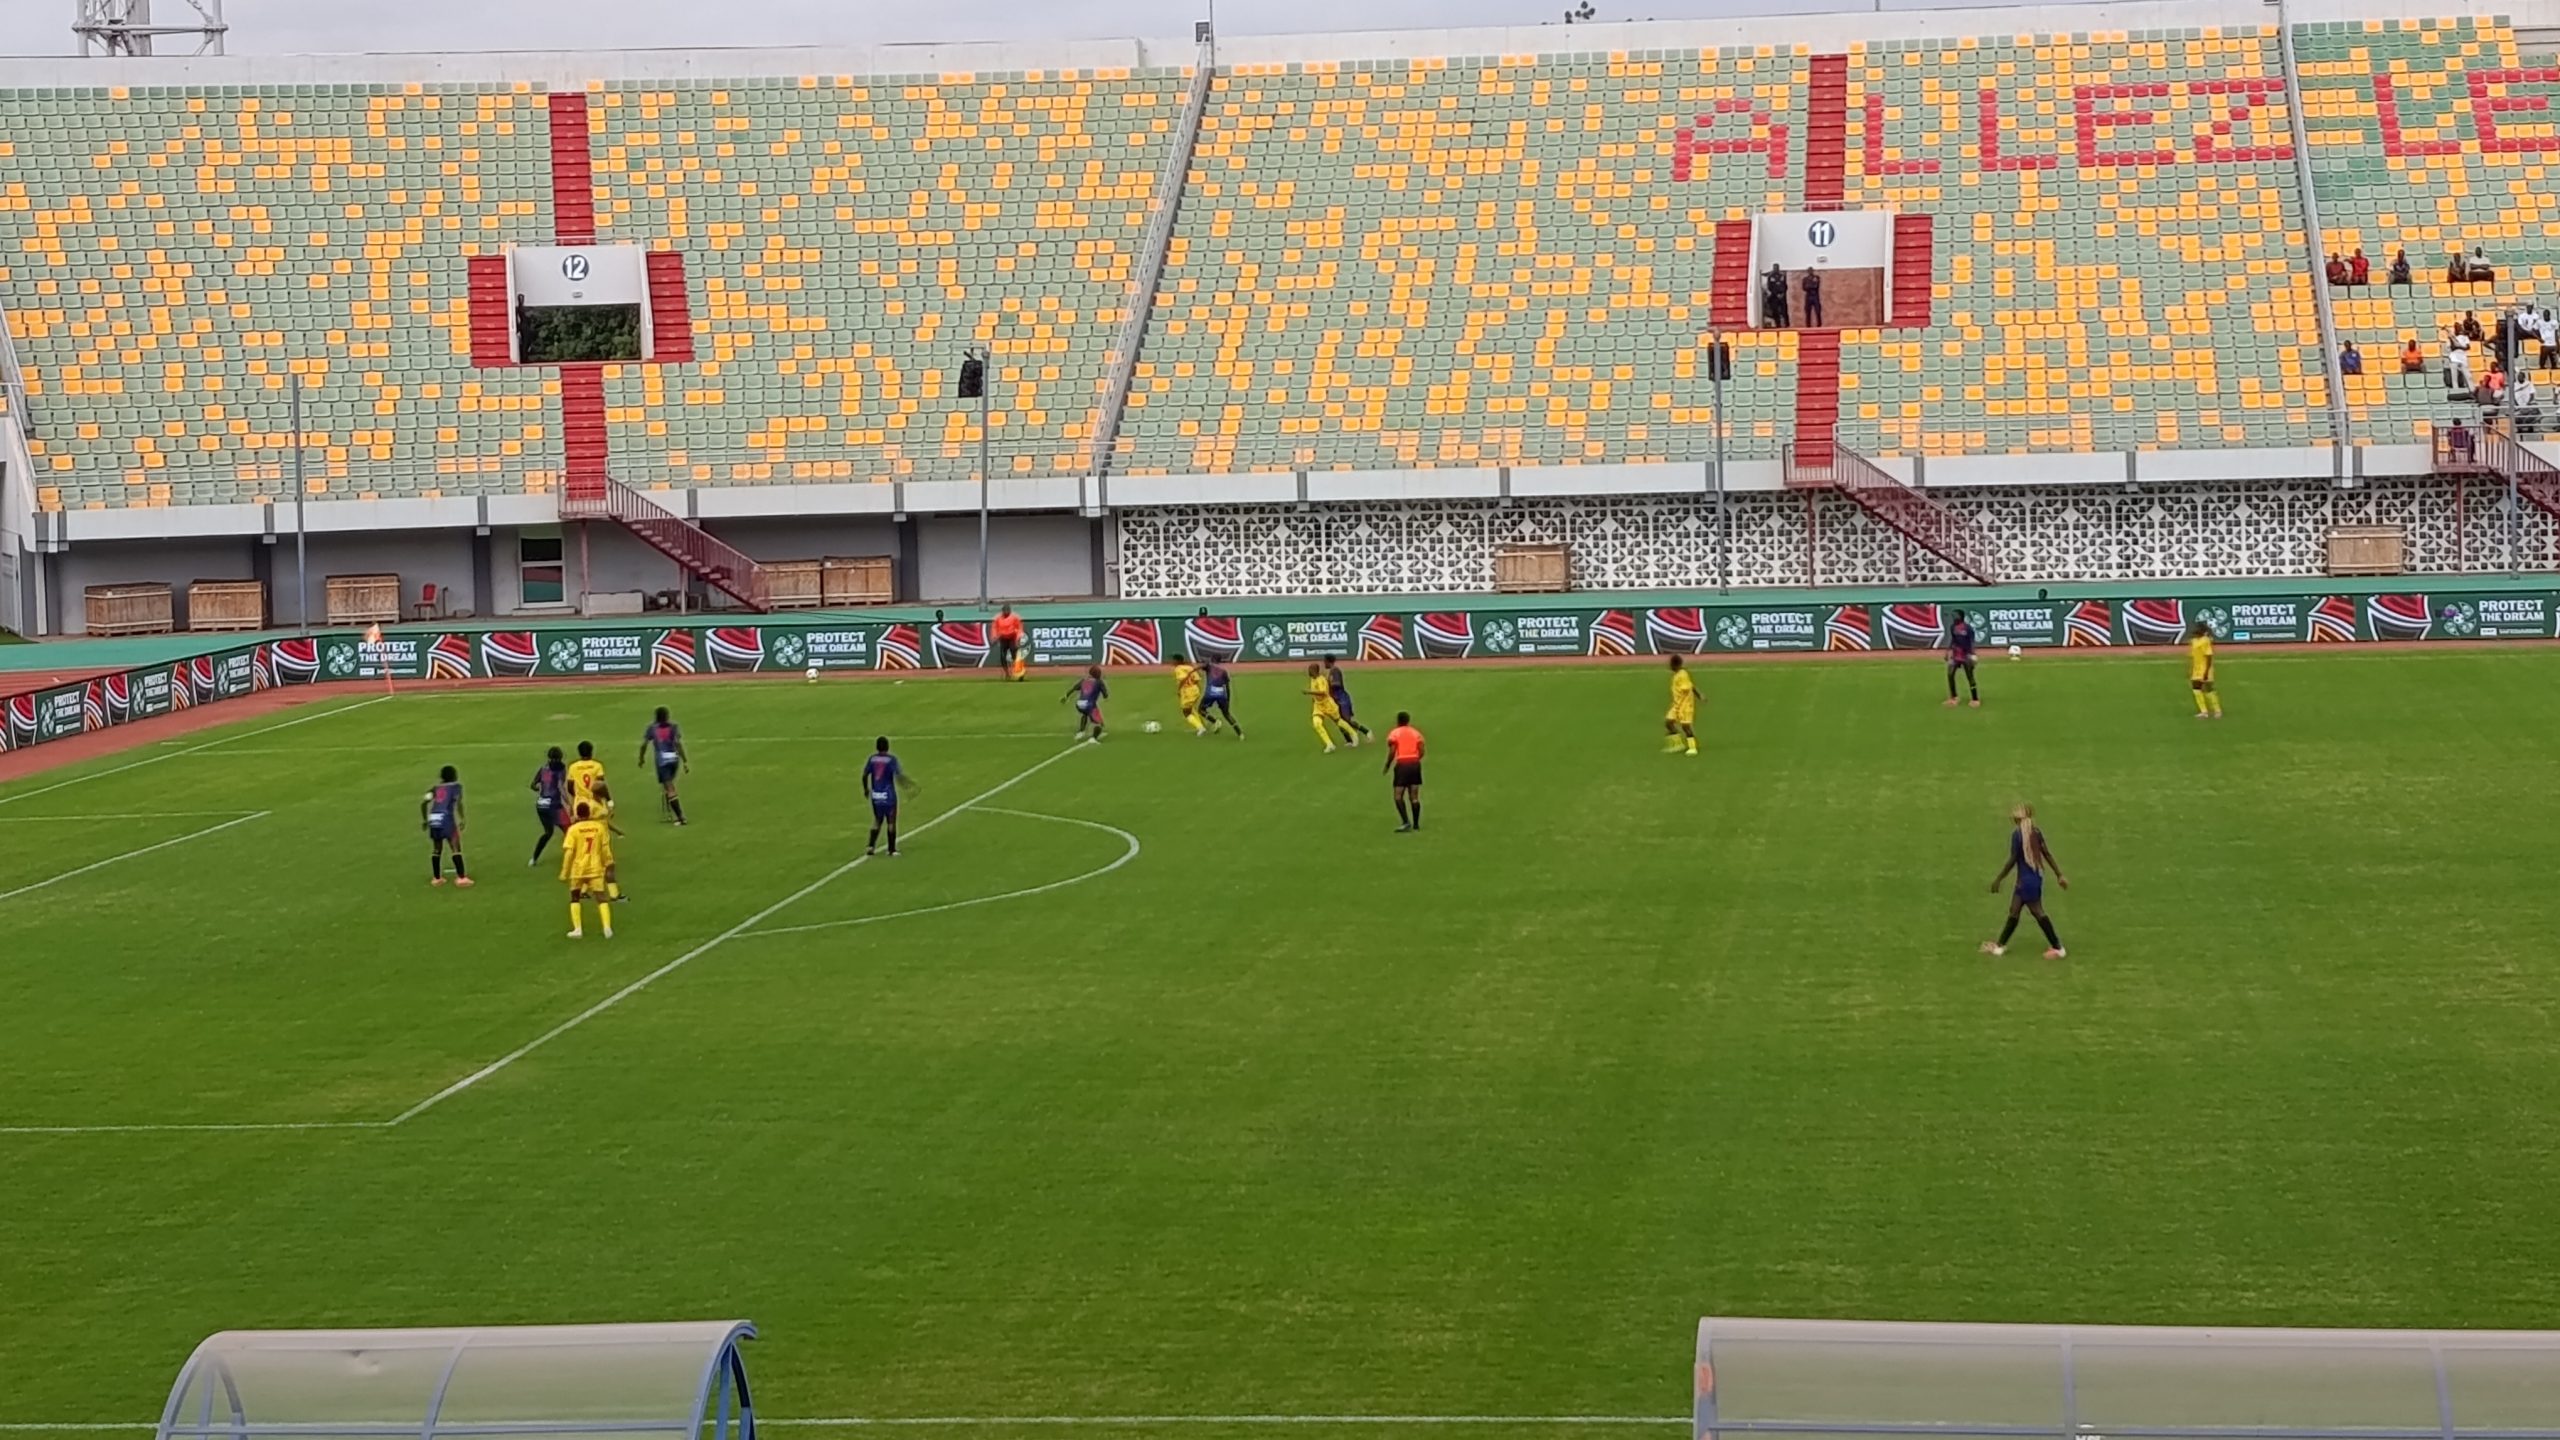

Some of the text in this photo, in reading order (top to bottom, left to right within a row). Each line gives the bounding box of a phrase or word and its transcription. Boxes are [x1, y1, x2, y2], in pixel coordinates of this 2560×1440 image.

[1671, 78, 2294, 182] ALLEZ
[1812, 222, 1830, 246] 11
[565, 256, 585, 279] 12
[2232, 604, 2297, 616] PROTECT
[2479, 599, 2544, 612] PROTECT
[1751, 612, 1814, 624] PROTECT
[1989, 608, 2053, 621] PROTECT
[2480, 611, 2545, 622] THE DREAM
[1287, 621, 1348, 633] PROTECT
[1517, 616, 1579, 628] PROTECT
[1990, 620, 2054, 631] THE DREAM
[2233, 616, 2297, 626] THE DREAM
[1032, 626, 1093, 639] PROTECT
[1518, 628, 1580, 638] THE DREAM
[1752, 624, 1814, 634] THE DREAM
[582, 636, 641, 648] PROTECT
[806, 631, 867, 644] PROTECT
[1033, 638, 1093, 649] THE DREAM
[1288, 632, 1348, 643] THE DREAM
[358, 641, 417, 653] PROTECT
[583, 647, 642, 658] THE DREAM
[807, 642, 867, 653] THE DREAM
[359, 652, 418, 663] THE DREAM
[585, 836, 594, 855] 7
